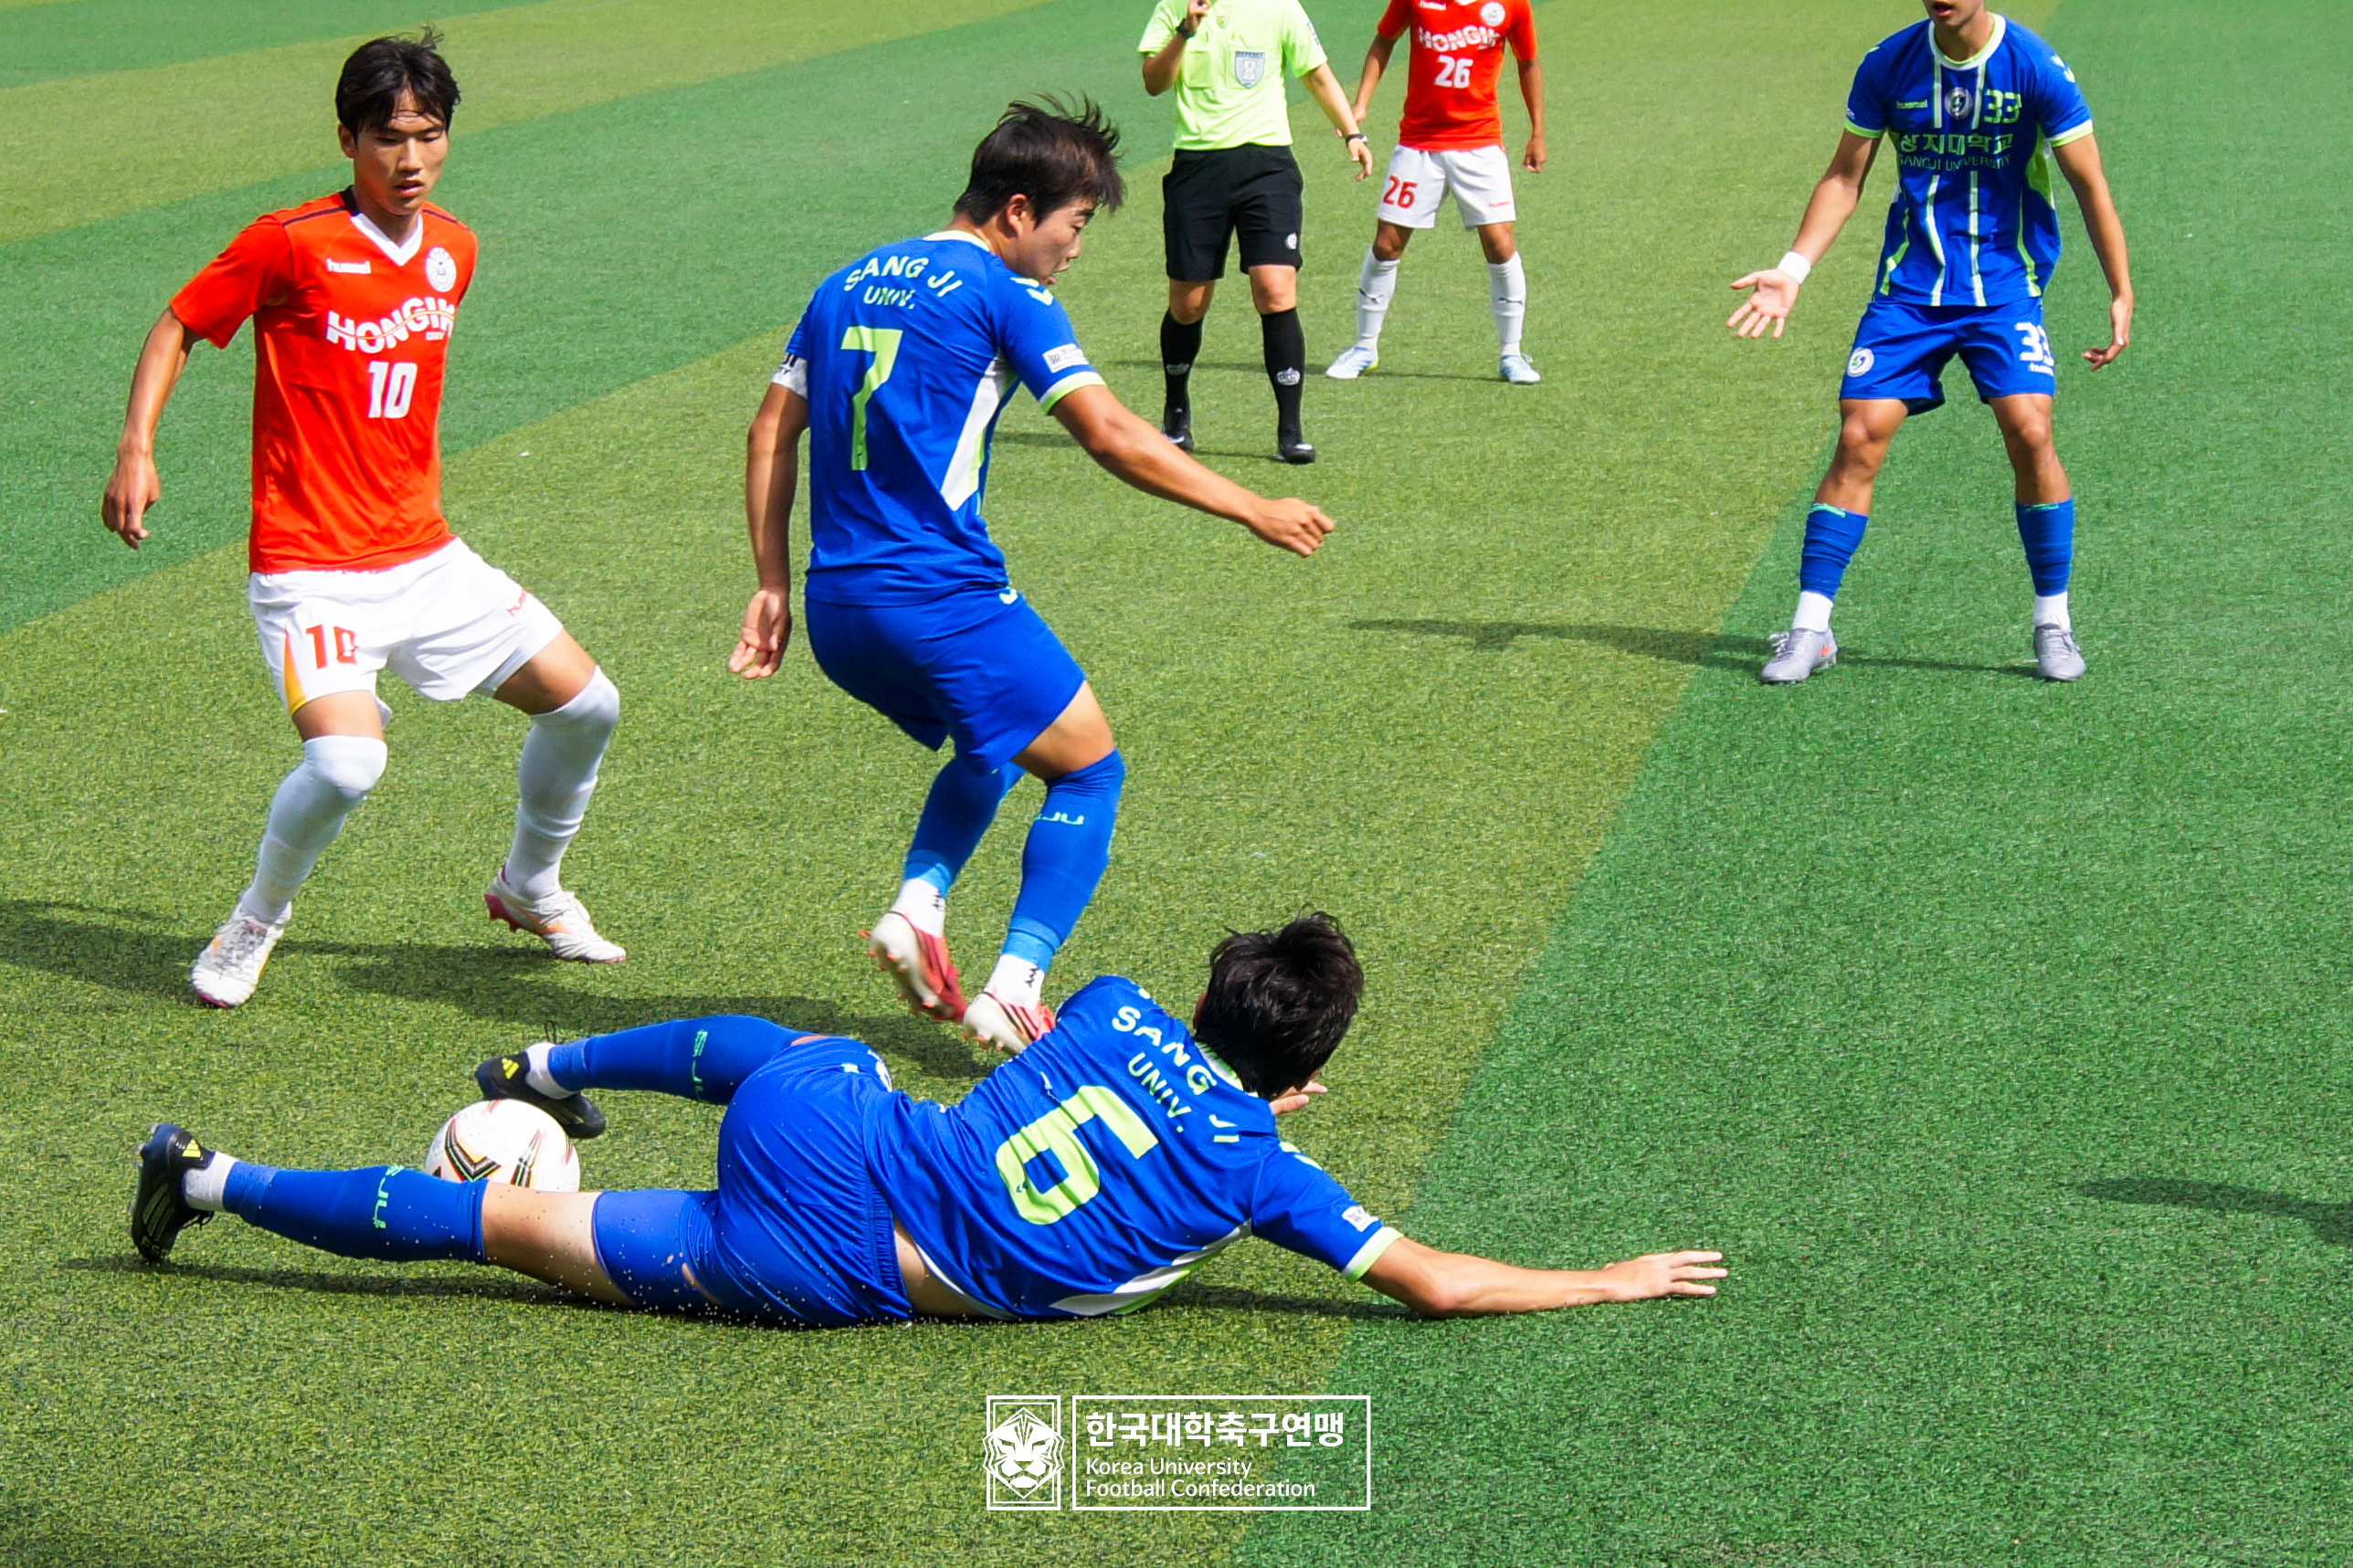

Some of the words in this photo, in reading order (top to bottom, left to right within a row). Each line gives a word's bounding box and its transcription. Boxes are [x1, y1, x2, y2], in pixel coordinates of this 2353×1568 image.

[1419, 26, 1501, 52] HONGIK
[1434, 55, 1473, 89] 26
[1983, 89, 2022, 124] 33
[1900, 132, 2014, 155] 상지대학교
[1383, 174, 1419, 209] 26
[844, 255, 930, 291] SANG
[927, 270, 964, 298] JI
[862, 285, 916, 310] UNIV.
[326, 297, 455, 354] HONGIK
[368, 361, 417, 419] 10
[840, 325, 903, 471] 7
[305, 624, 360, 670] 10
[1112, 1005, 1218, 1096] SANG
[1208, 1113, 1240, 1143] JI
[1127, 1051, 1192, 1133] UNIV.
[996, 1085, 1160, 1226] 6
